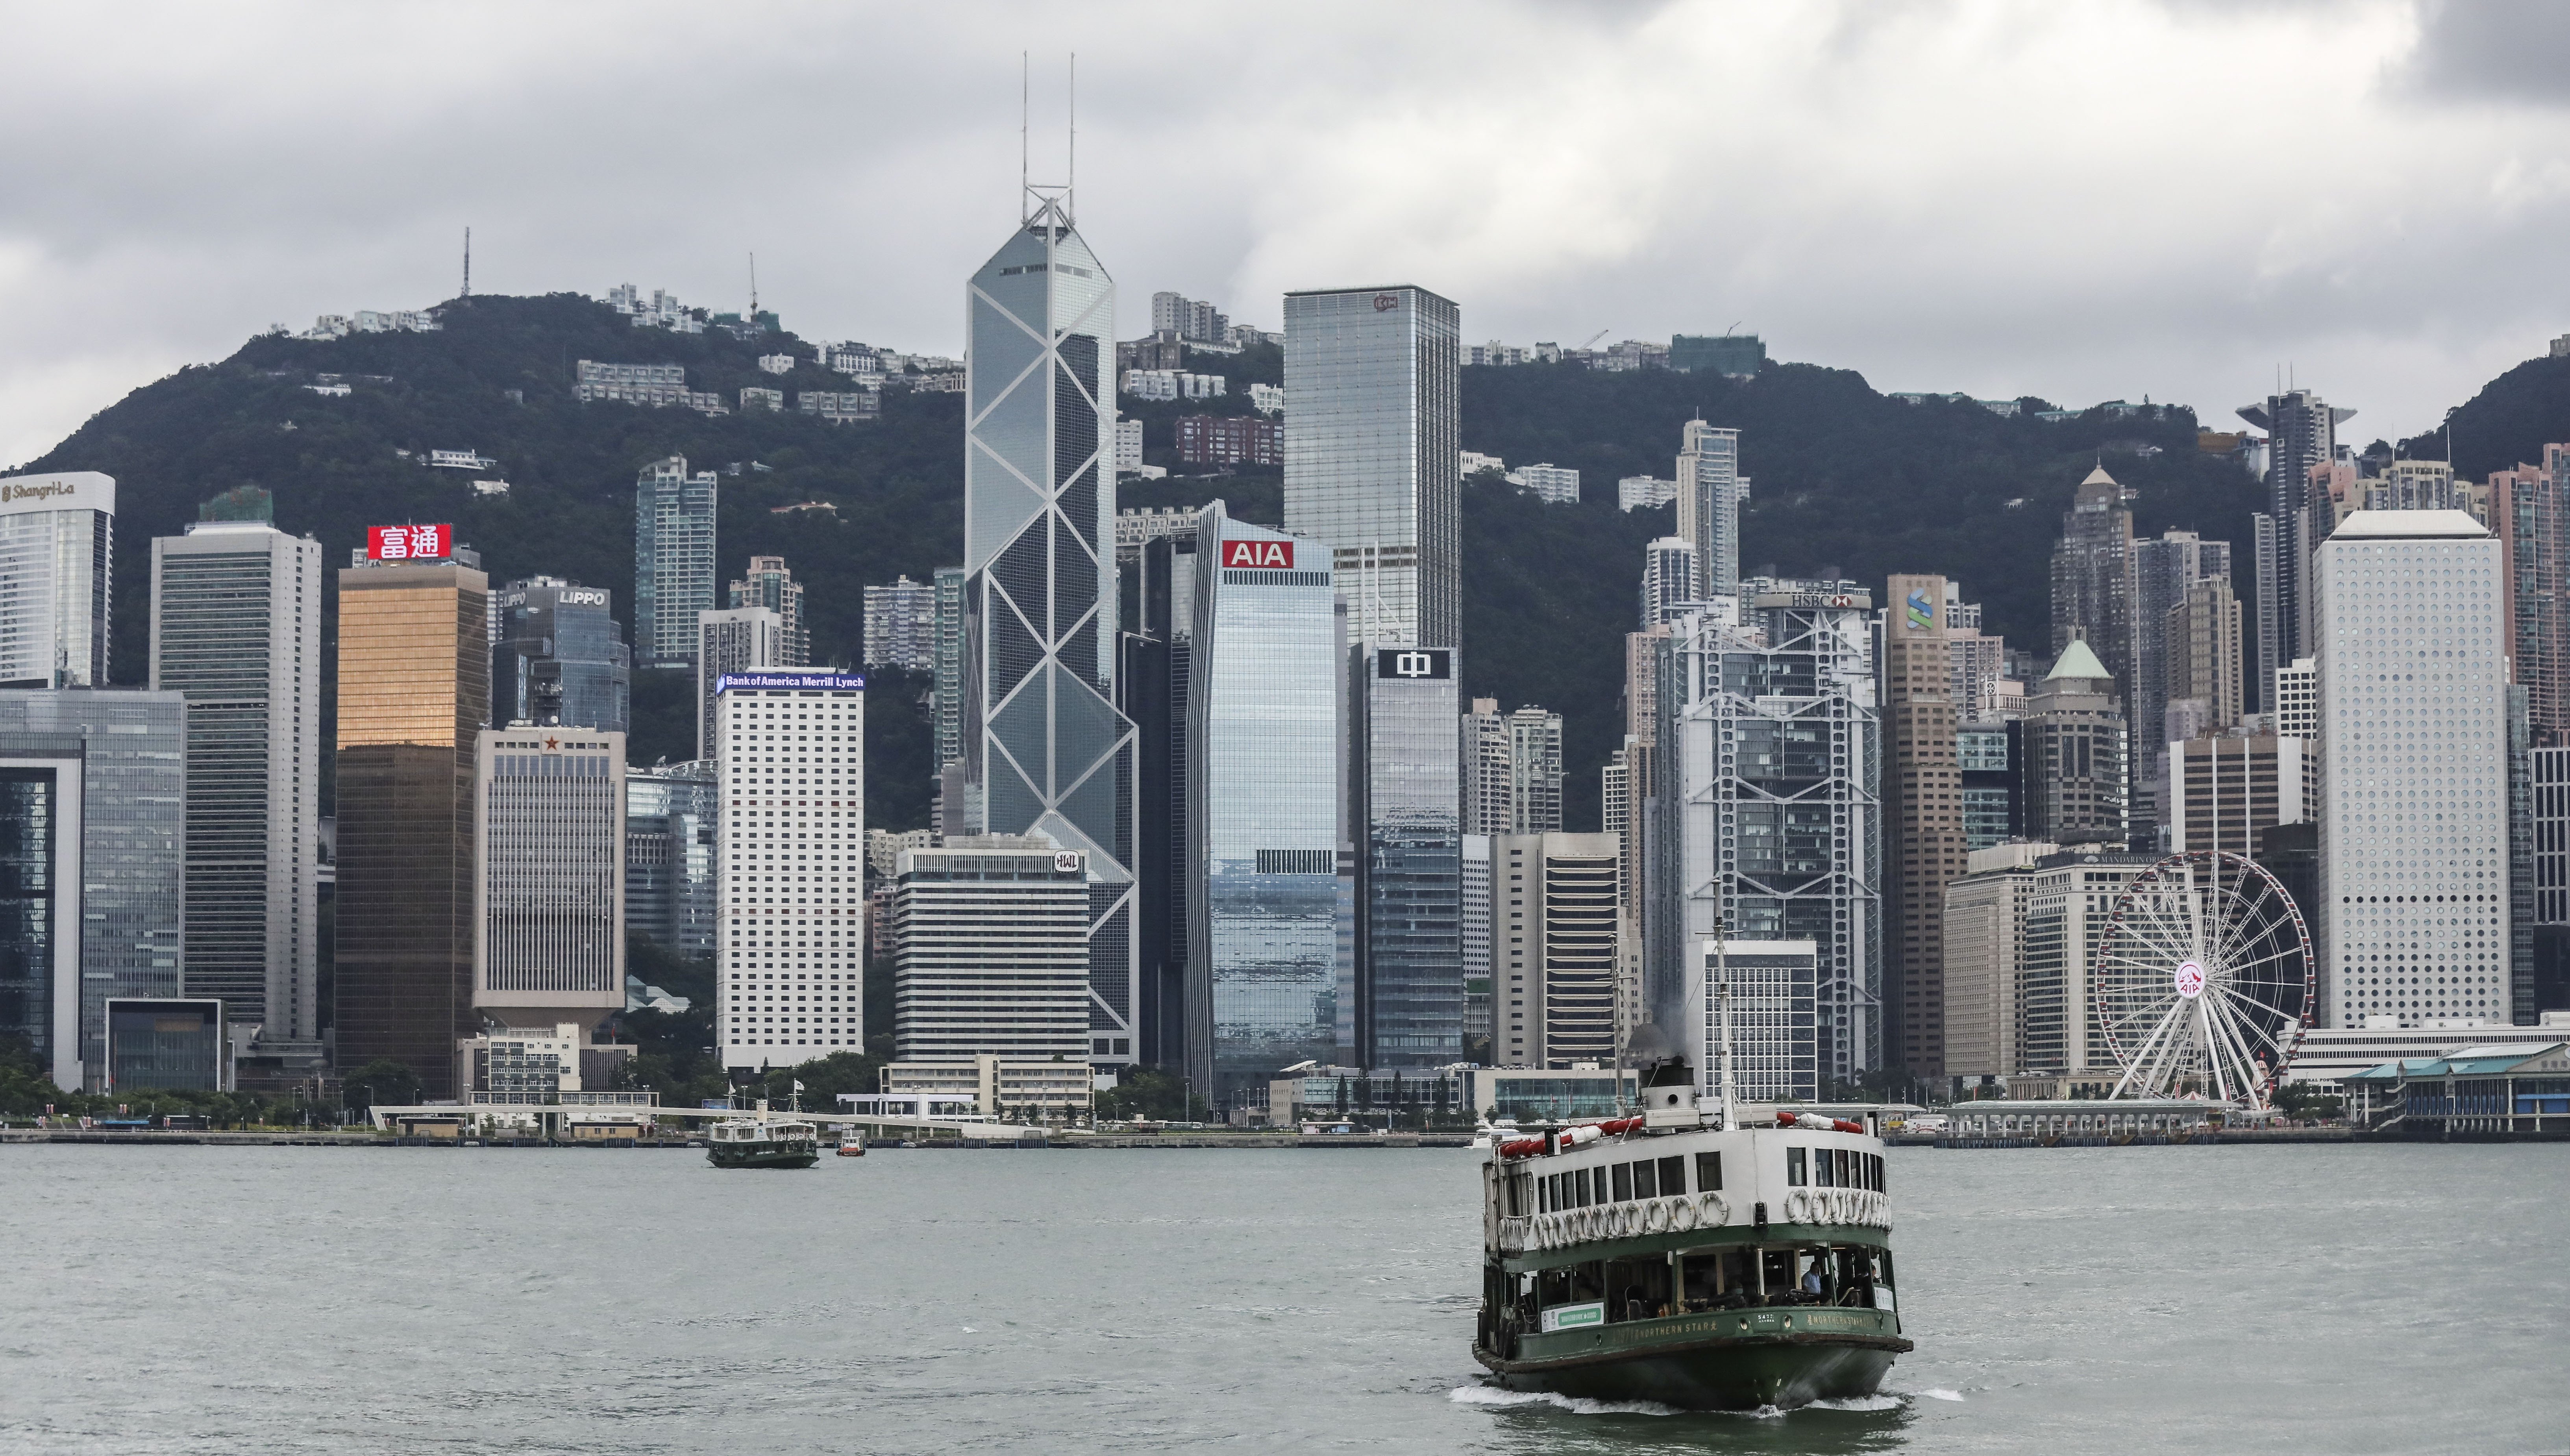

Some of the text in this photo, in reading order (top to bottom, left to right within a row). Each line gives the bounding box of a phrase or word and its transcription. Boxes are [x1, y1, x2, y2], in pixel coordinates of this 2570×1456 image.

[13, 481, 74, 500] Shangri-La
[381, 526, 439, 558] 富通
[1231, 543, 1287, 566] AIA
[504, 592, 526, 607] LIPPO
[559, 591, 605, 605] LIPPO
[1792, 595, 1830, 607] HSBC
[726, 676, 750, 685] Bank
[751, 676, 761, 685] of
[761, 676, 800, 686] America
[802, 677, 833, 686] Merrill
[836, 677, 864, 688] Lynch
[2181, 984, 2200, 994] AIA
[1640, 1325, 1682, 1338] NORTHERN
[1686, 1322, 1708, 1332] STAR
